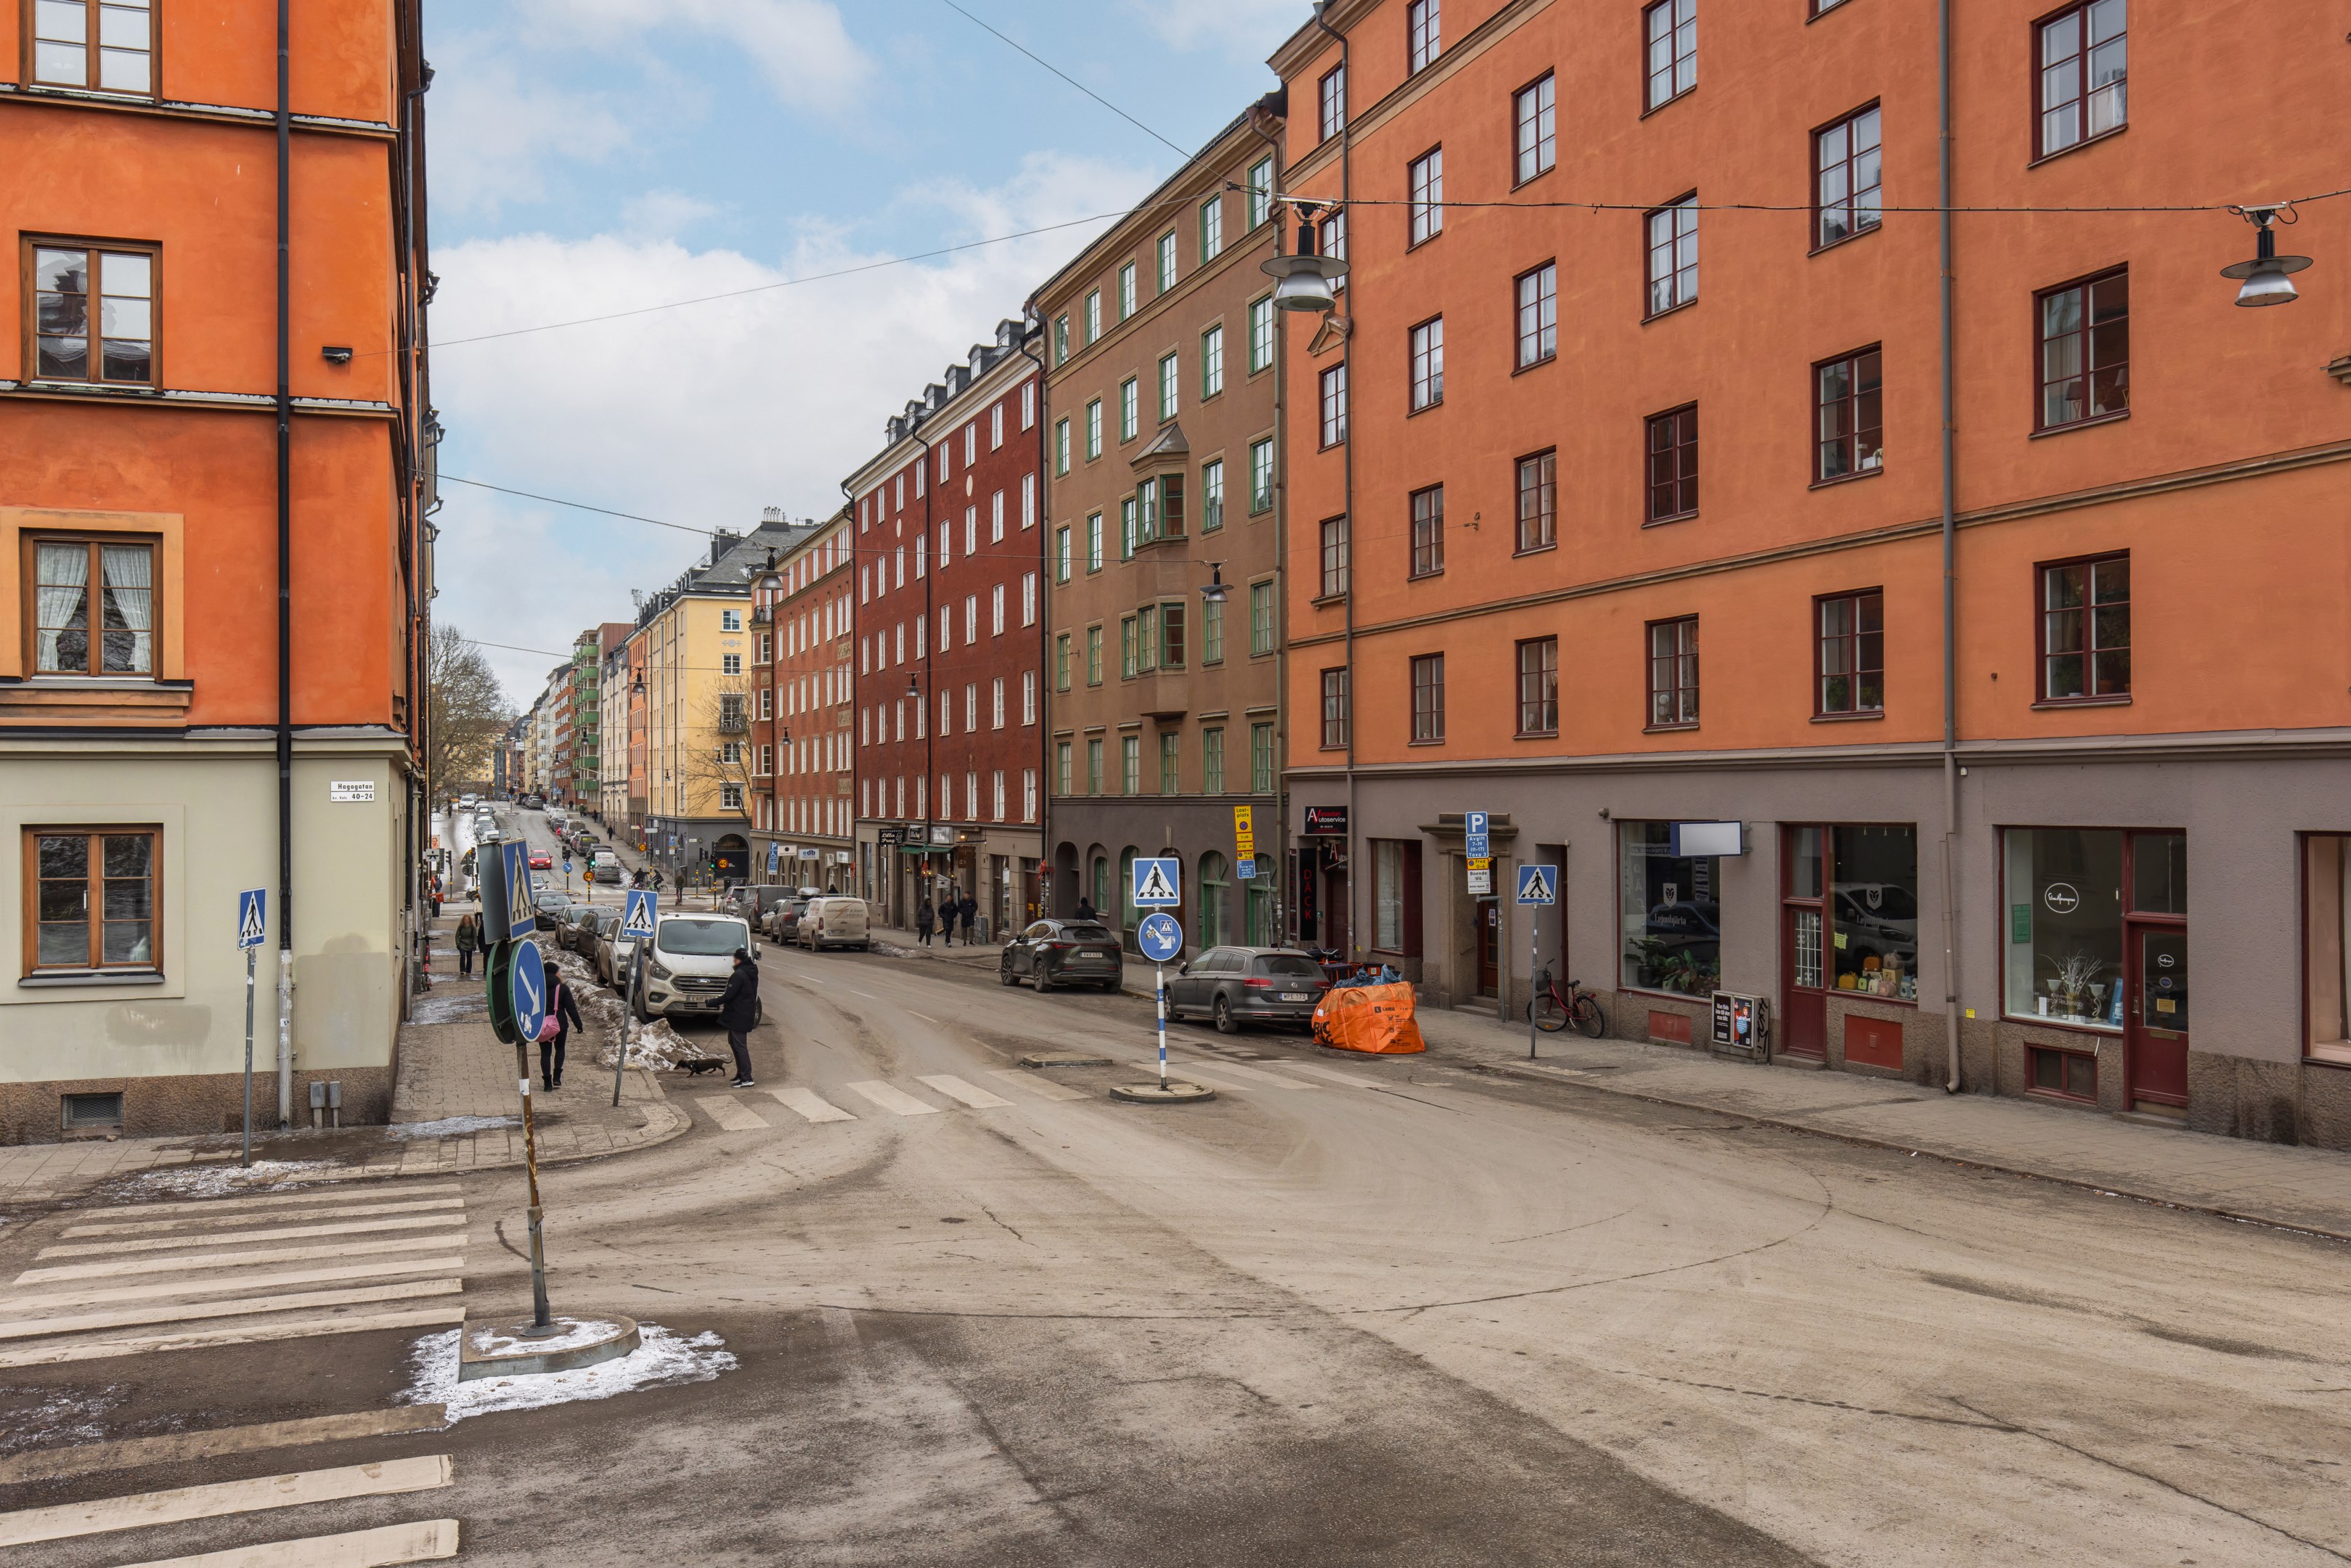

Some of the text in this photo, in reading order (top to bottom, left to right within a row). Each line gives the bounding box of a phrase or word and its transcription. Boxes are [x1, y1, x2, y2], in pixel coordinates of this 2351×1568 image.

[1307, 808, 1346, 822] Autoservice
[1471, 814, 1484, 833] P
[1655, 912, 1687, 927] Lejonhjärta
